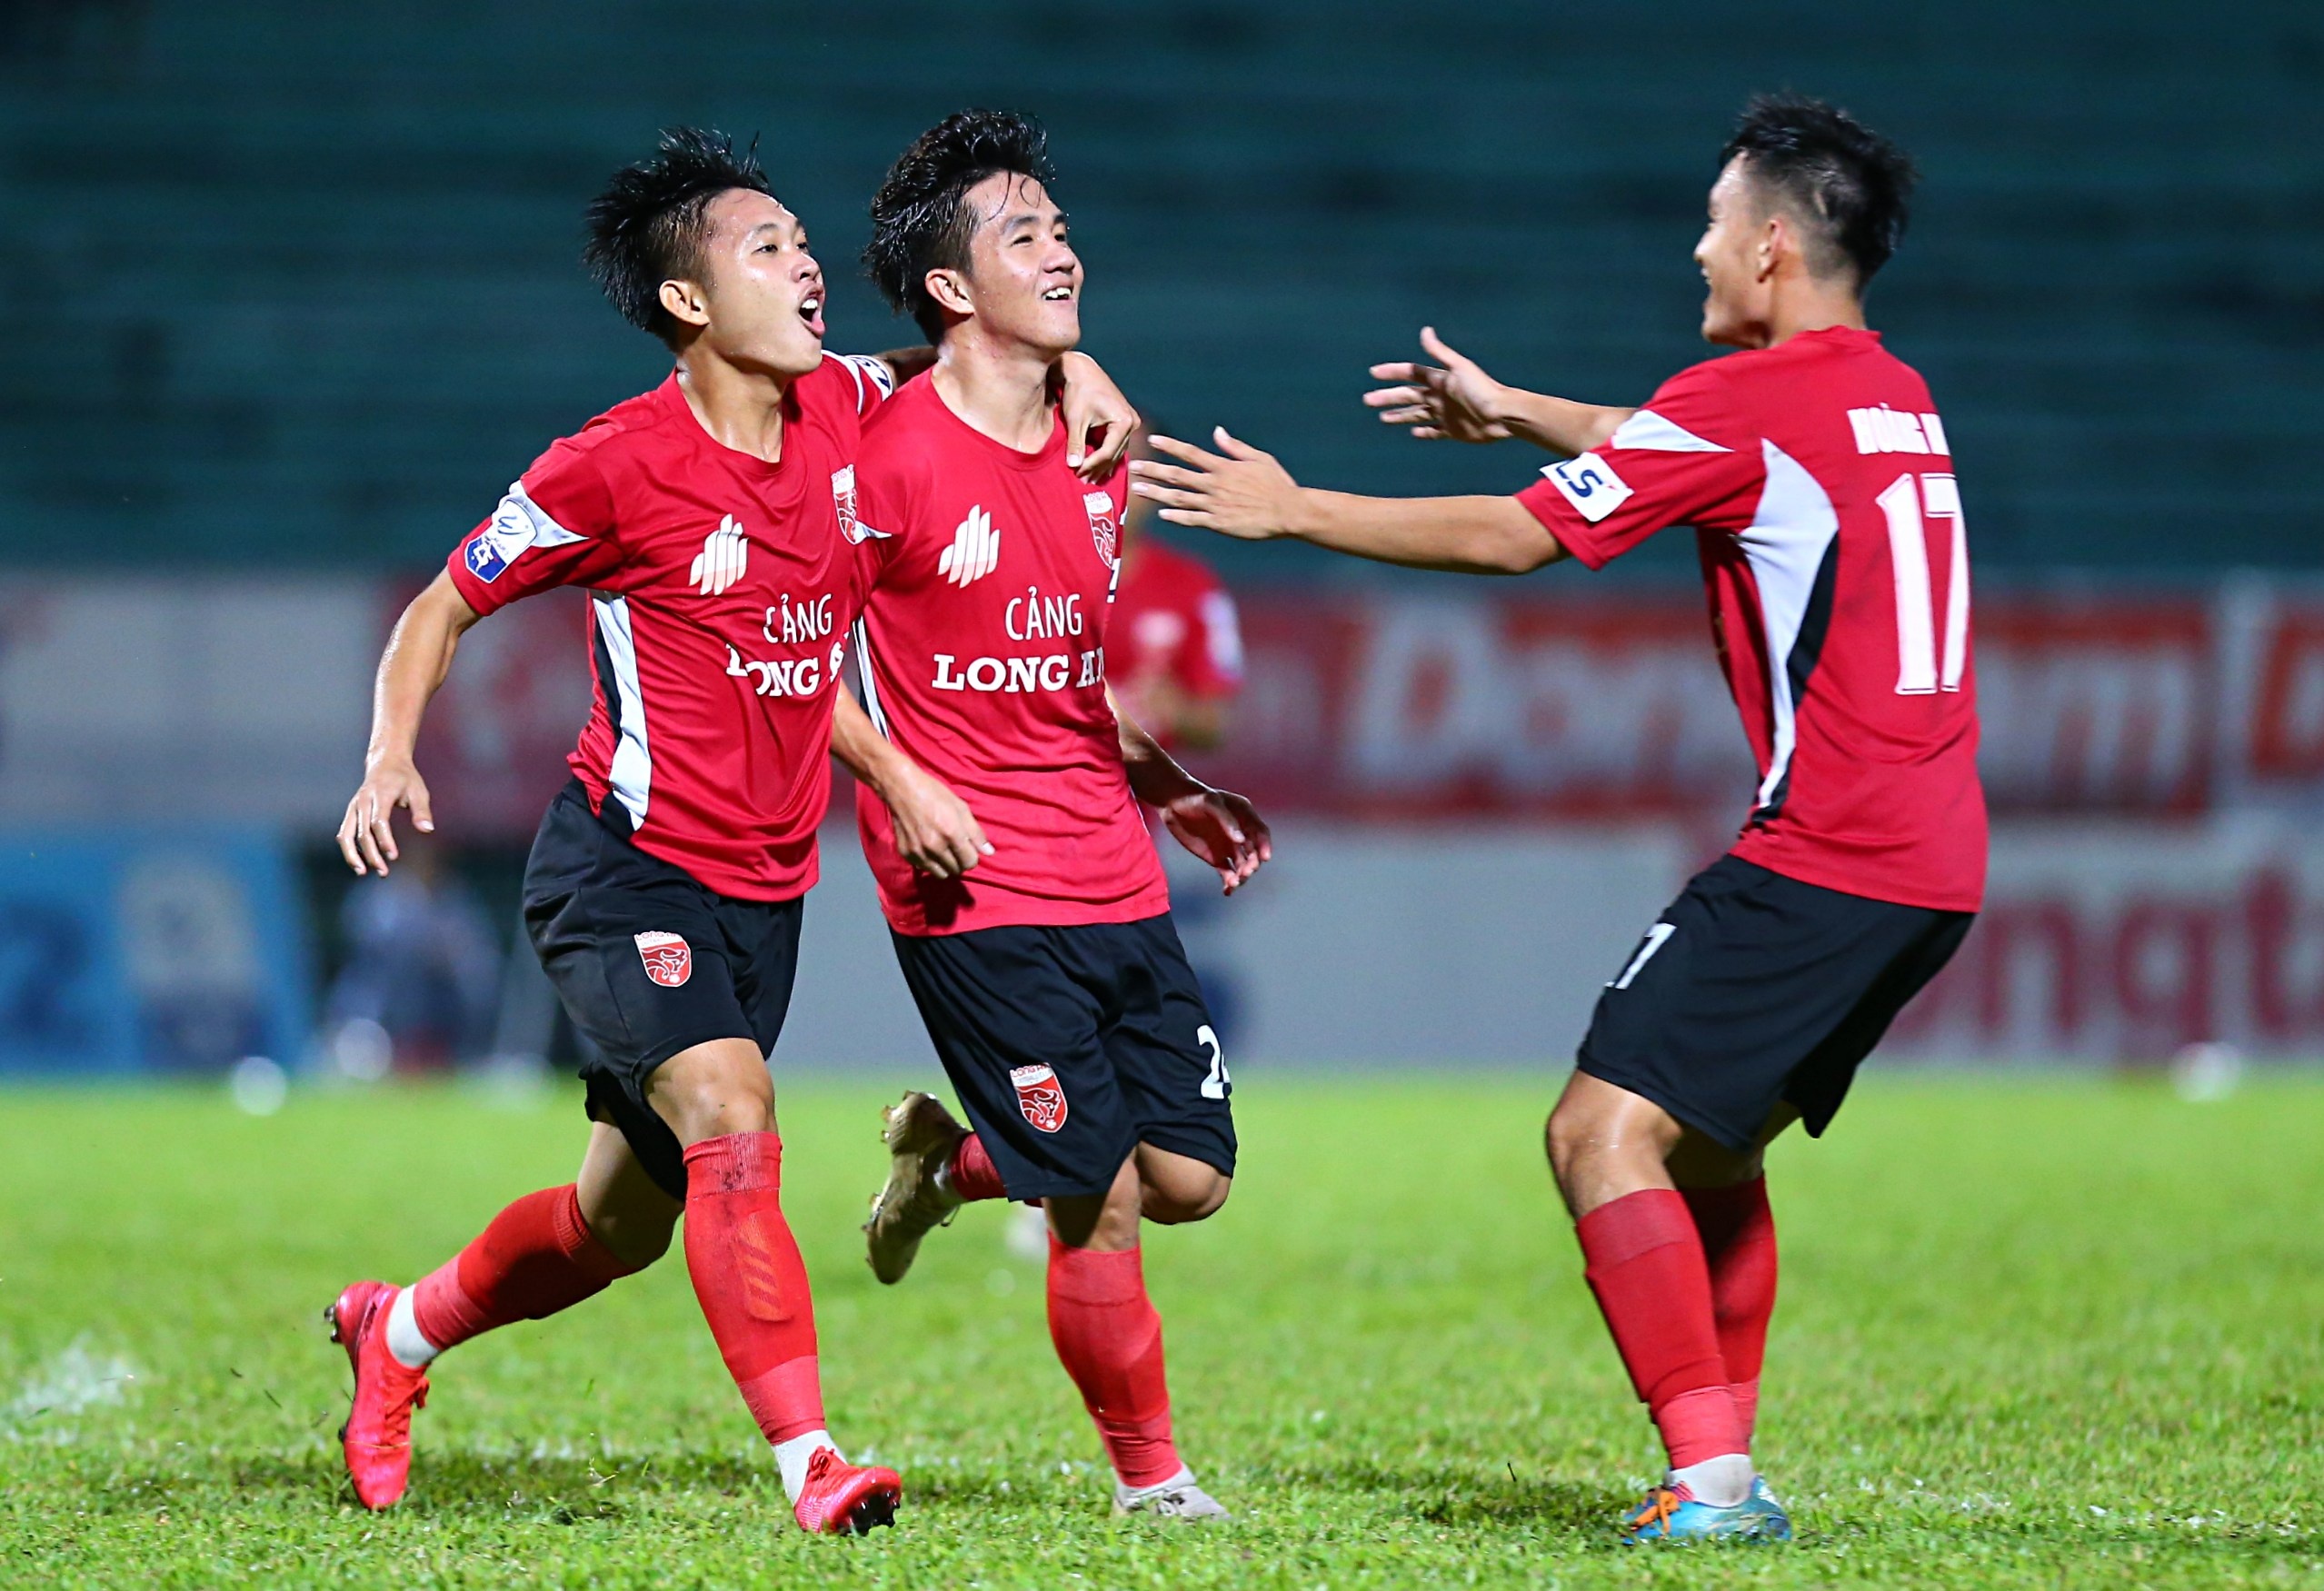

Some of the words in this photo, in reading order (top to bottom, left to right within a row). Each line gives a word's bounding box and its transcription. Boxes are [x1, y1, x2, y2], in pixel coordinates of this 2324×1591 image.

[1875, 472, 1970, 695] 17
[763, 593, 833, 643] CẢNG
[1005, 586, 1083, 641] CẢNG
[932, 653, 1070, 693] LONG
[1603, 922, 1678, 990] 7
